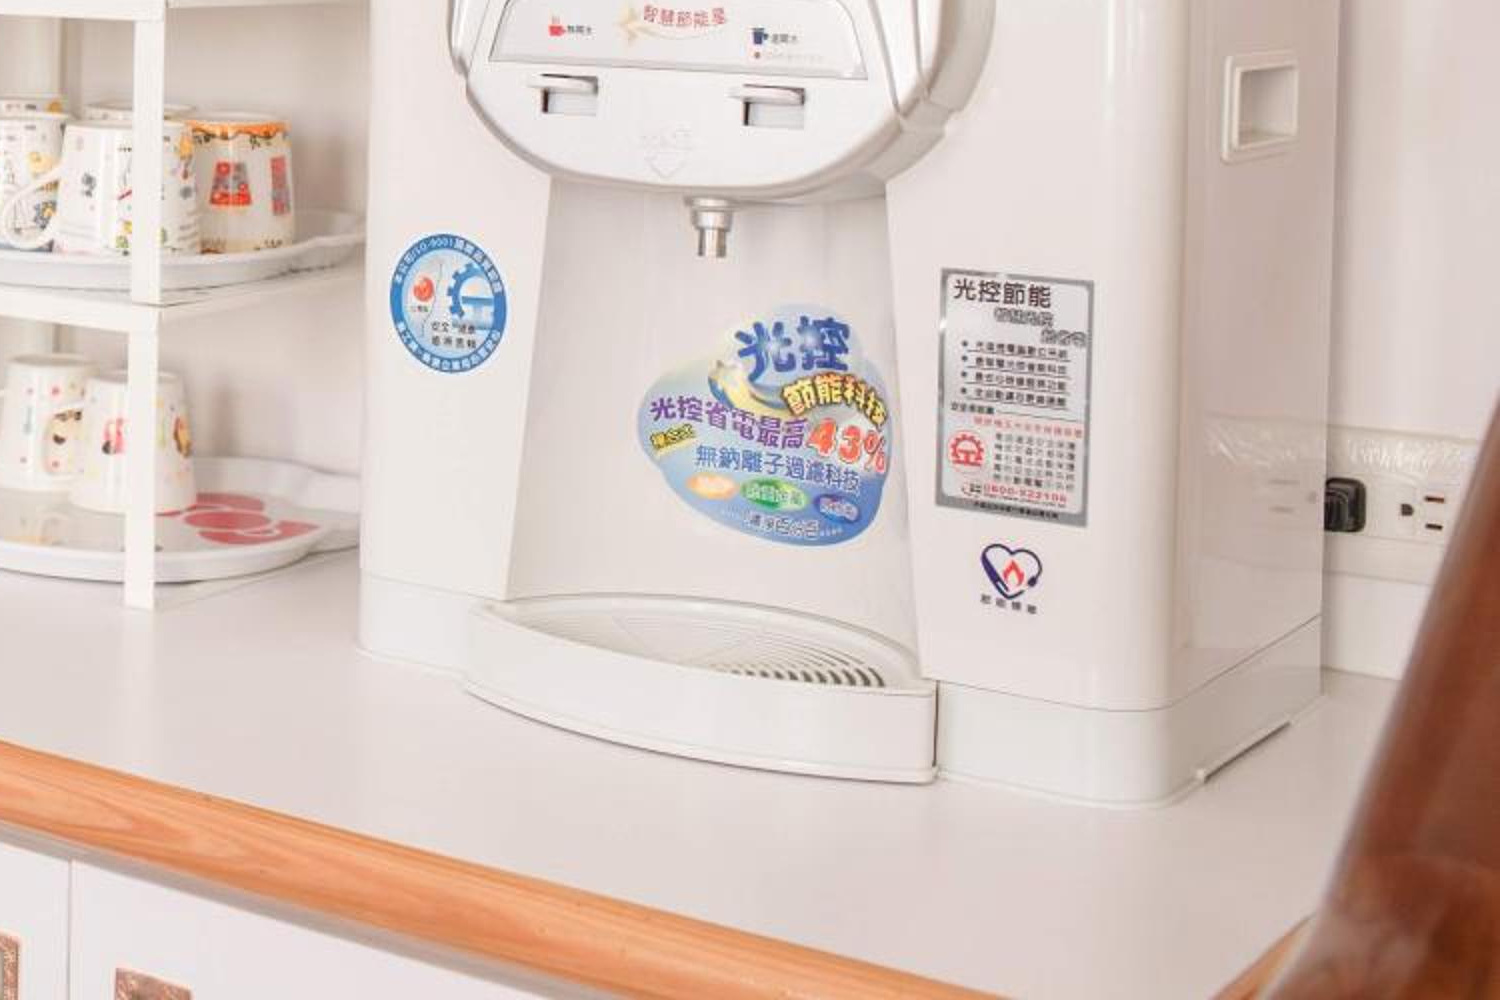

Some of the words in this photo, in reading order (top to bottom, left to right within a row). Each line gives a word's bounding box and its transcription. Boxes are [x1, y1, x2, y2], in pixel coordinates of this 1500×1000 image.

[953, 277, 1052, 309] 光控節能
[735, 316, 850, 381] 光控
[650, 395, 808, 450] 光控省電最高
[807, 416, 886, 473] 43%
